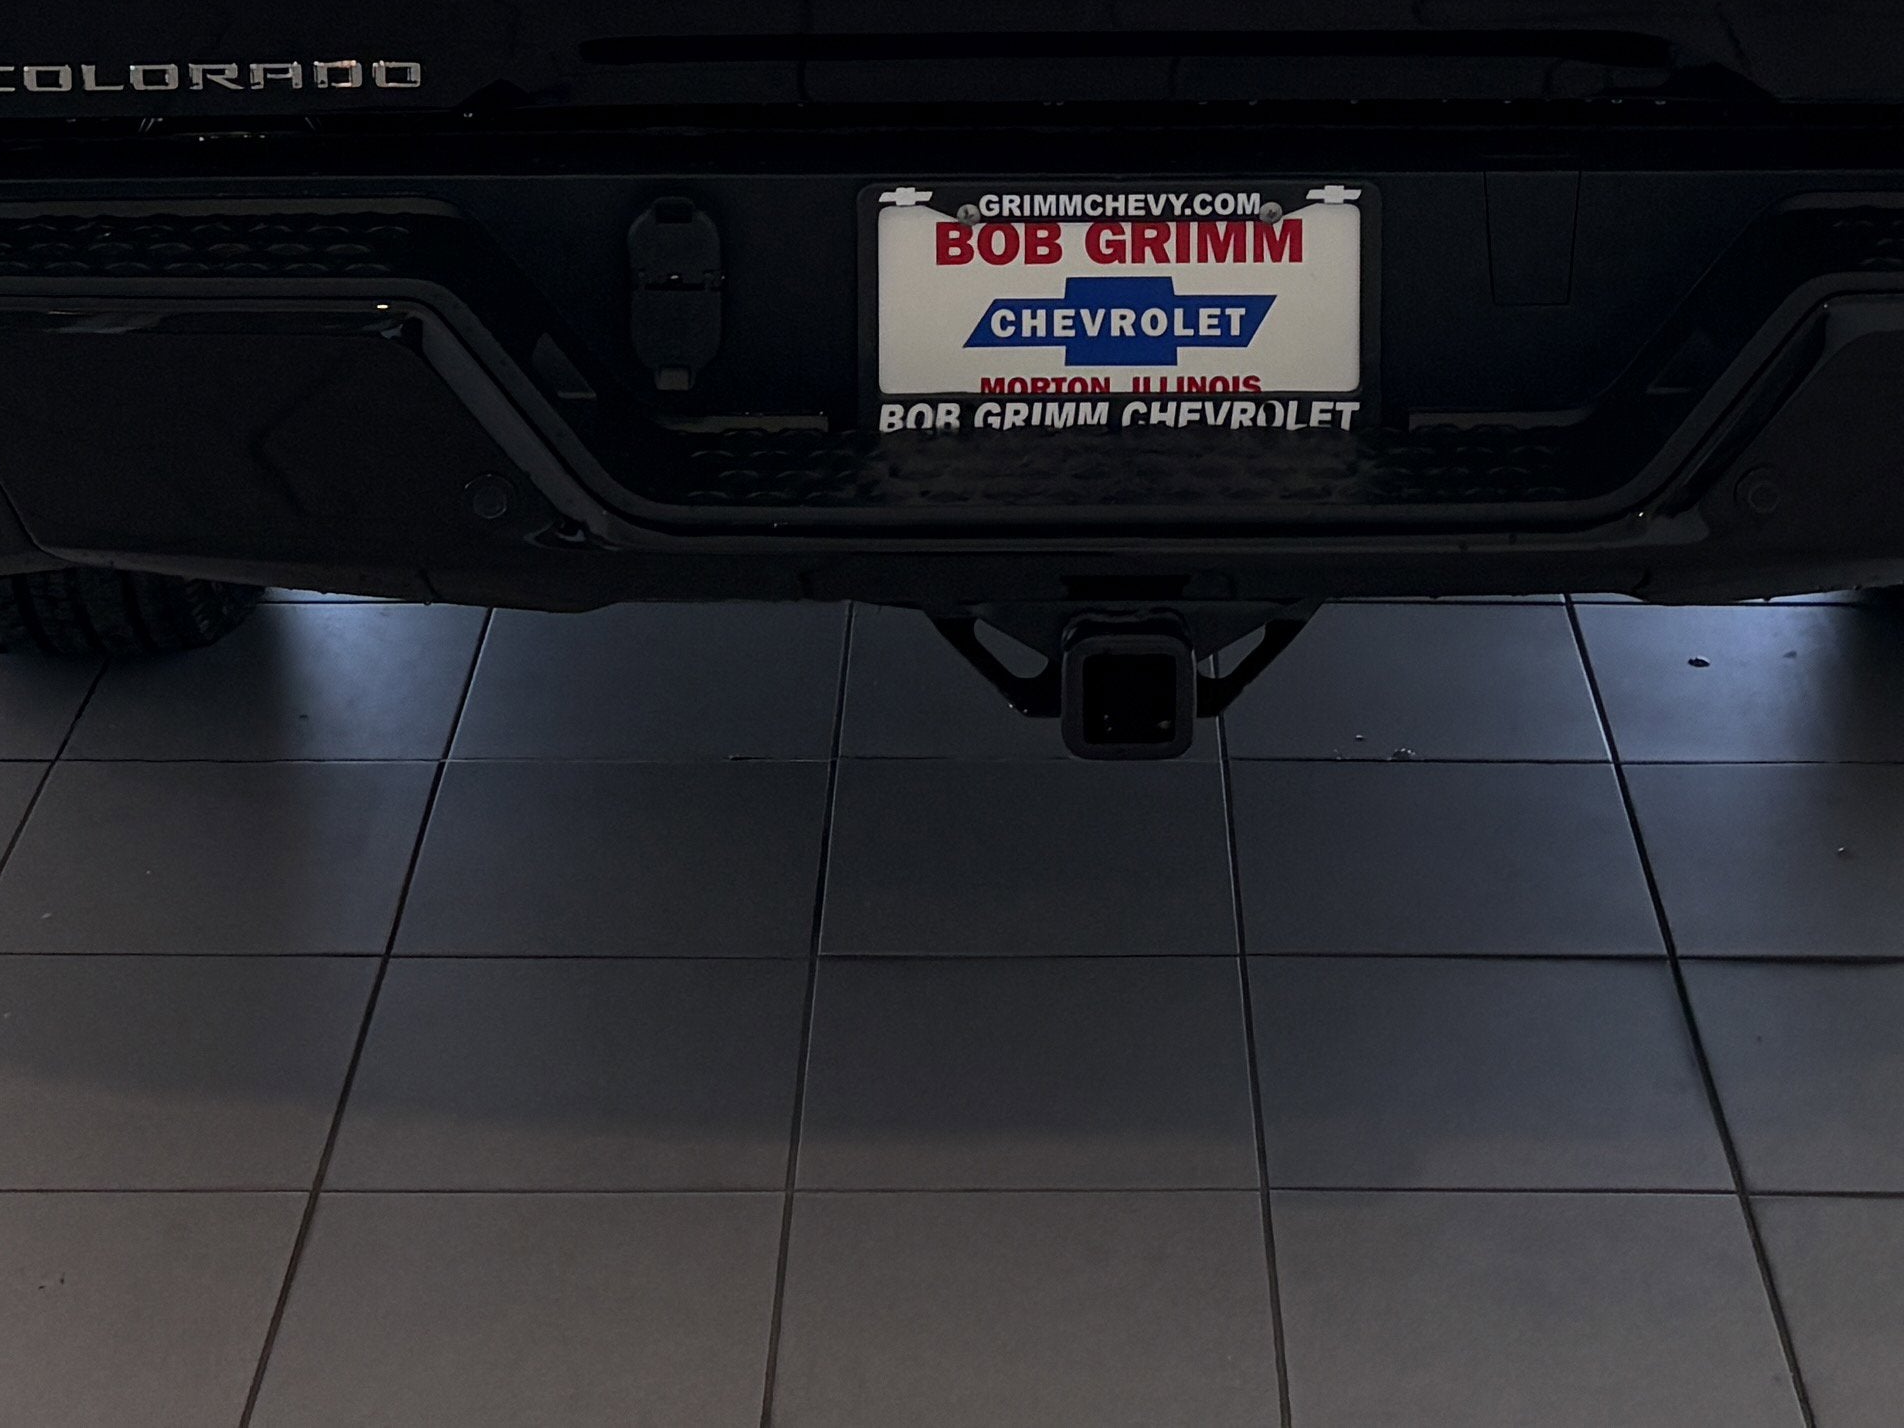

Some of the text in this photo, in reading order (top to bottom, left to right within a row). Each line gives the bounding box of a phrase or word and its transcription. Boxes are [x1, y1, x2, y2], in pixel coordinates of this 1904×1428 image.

[978, 192, 1261, 218] GRIMMCHEVY.COM
[935, 218, 1304, 266] BOB GRIMM
[990, 306, 1247, 338] CHEVROLET
[878, 399, 1361, 434] BOB GRIMM CHEVROLET
